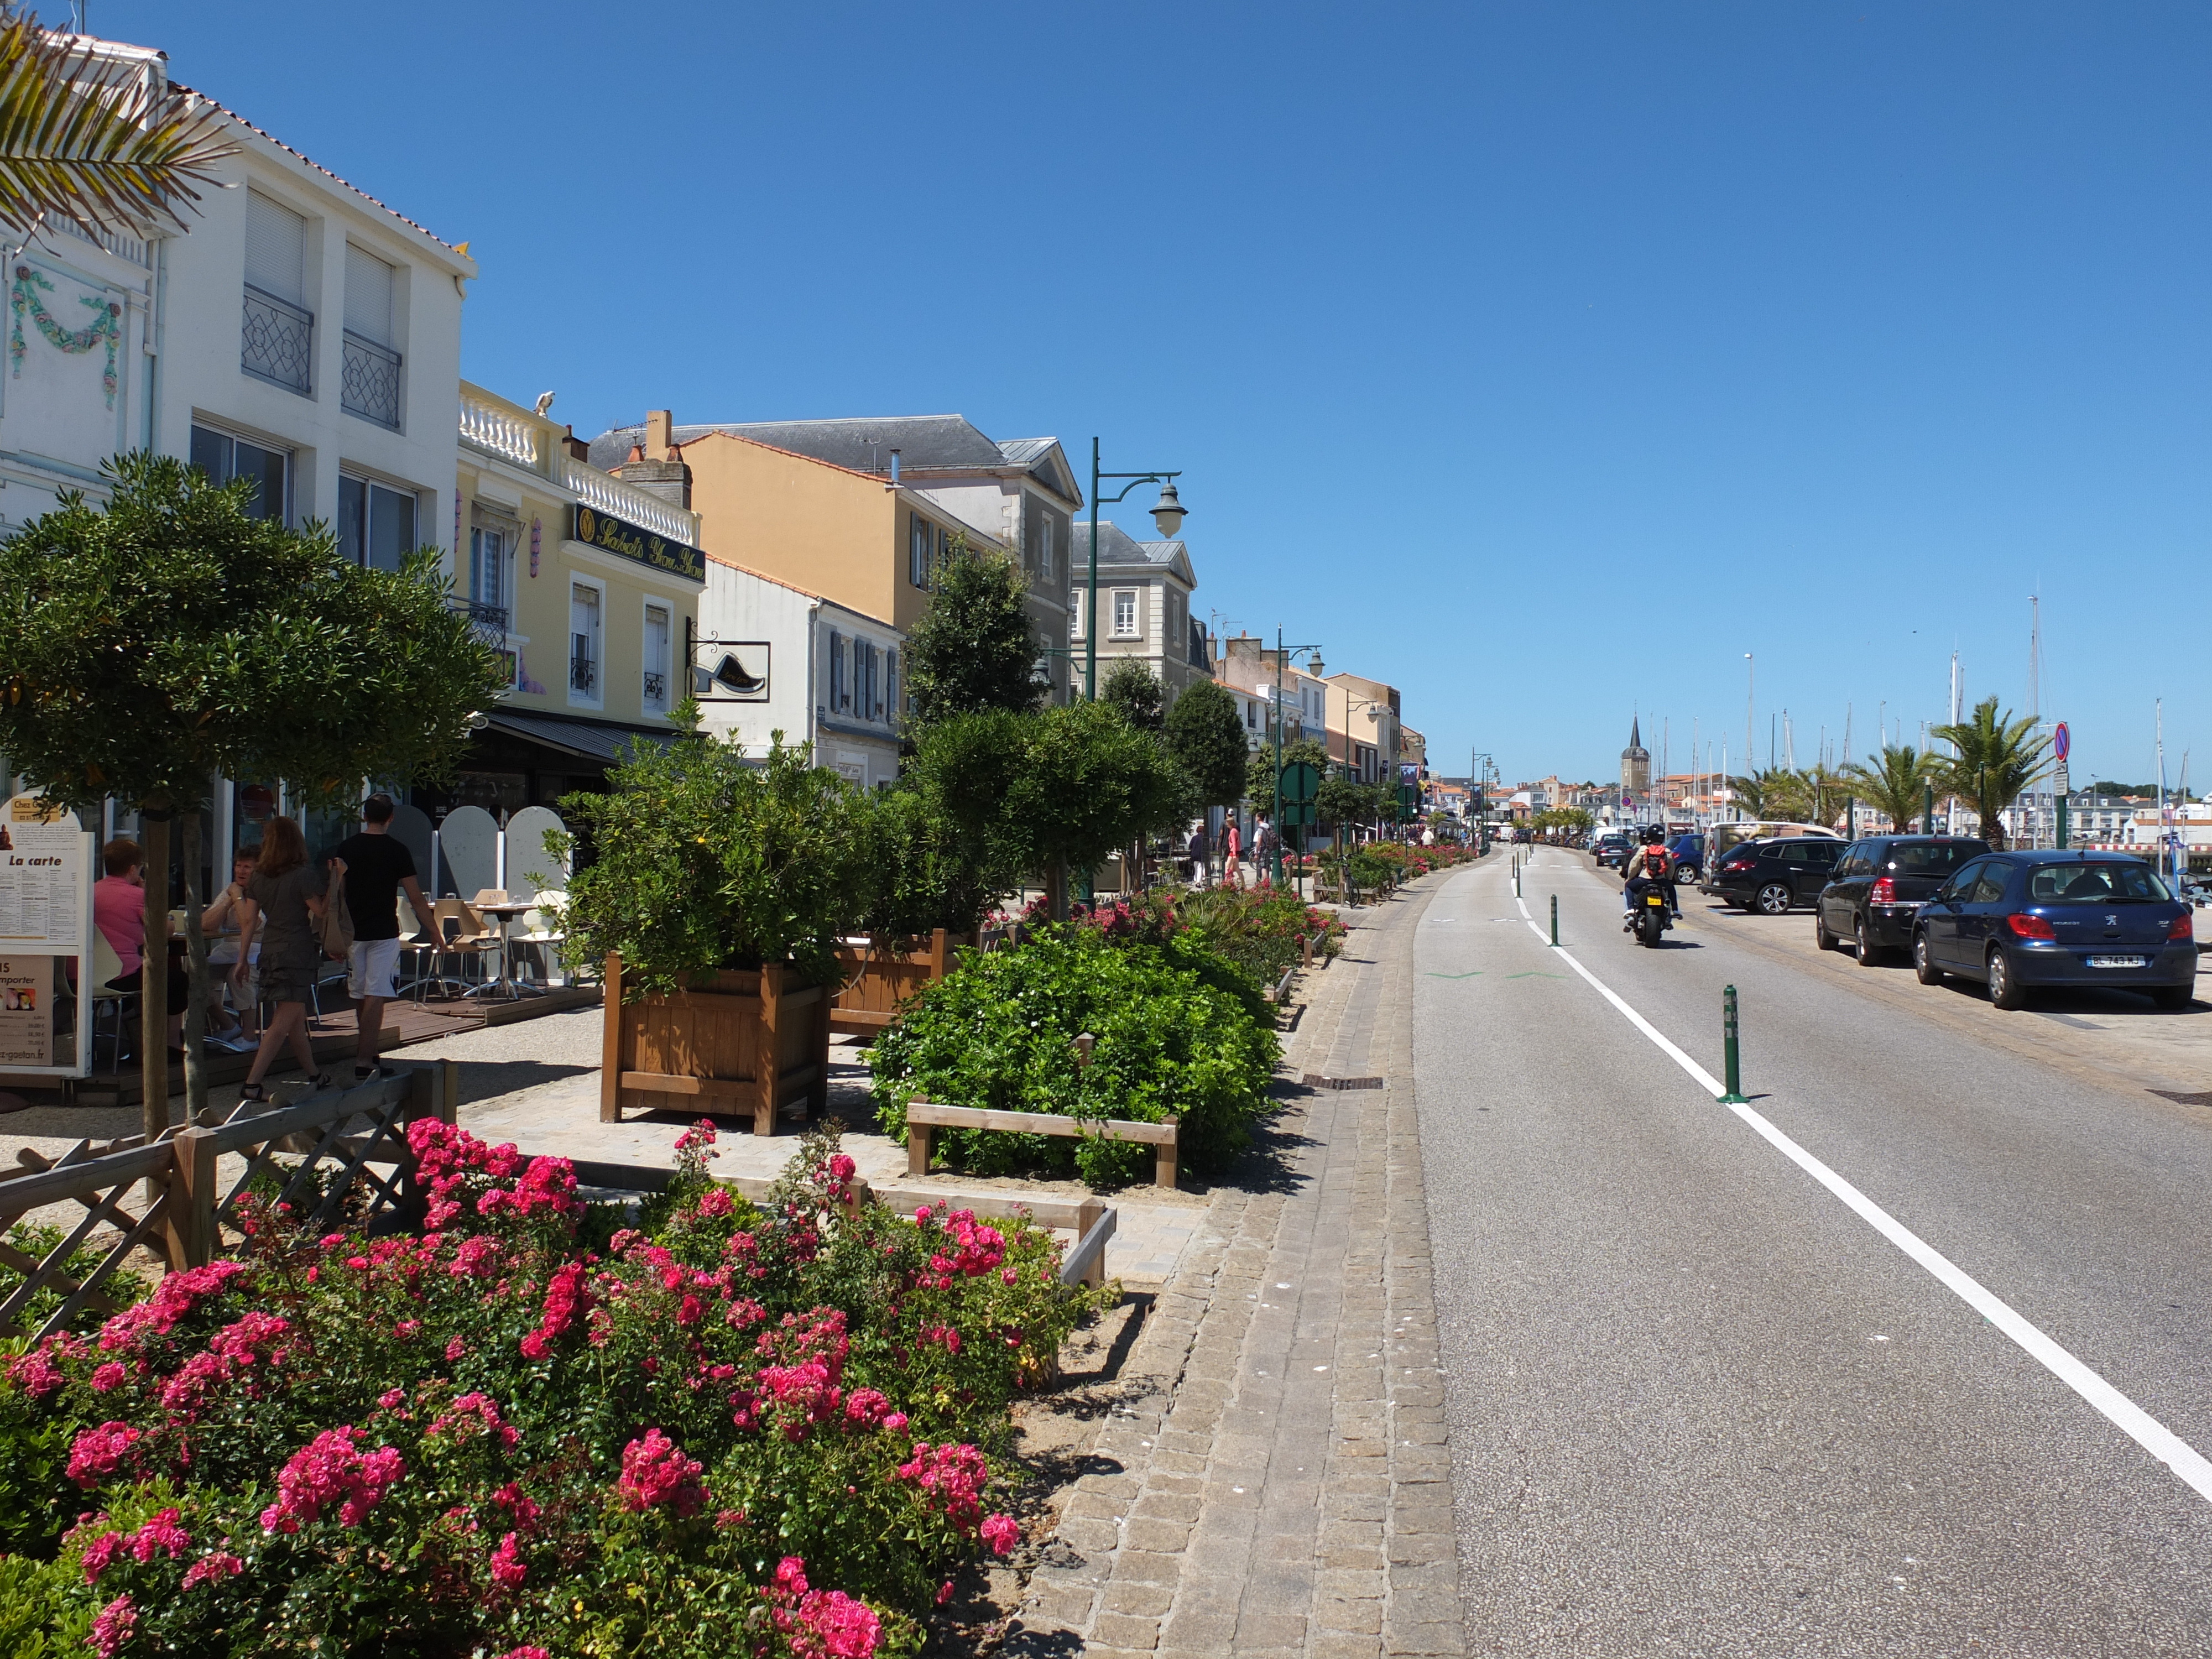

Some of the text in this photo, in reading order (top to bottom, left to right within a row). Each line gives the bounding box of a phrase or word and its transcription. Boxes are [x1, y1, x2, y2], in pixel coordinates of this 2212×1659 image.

[596, 518, 644, 559] Sabots
[9, 855, 61, 866] La carte
[2107, 957, 2125, 965] 743
